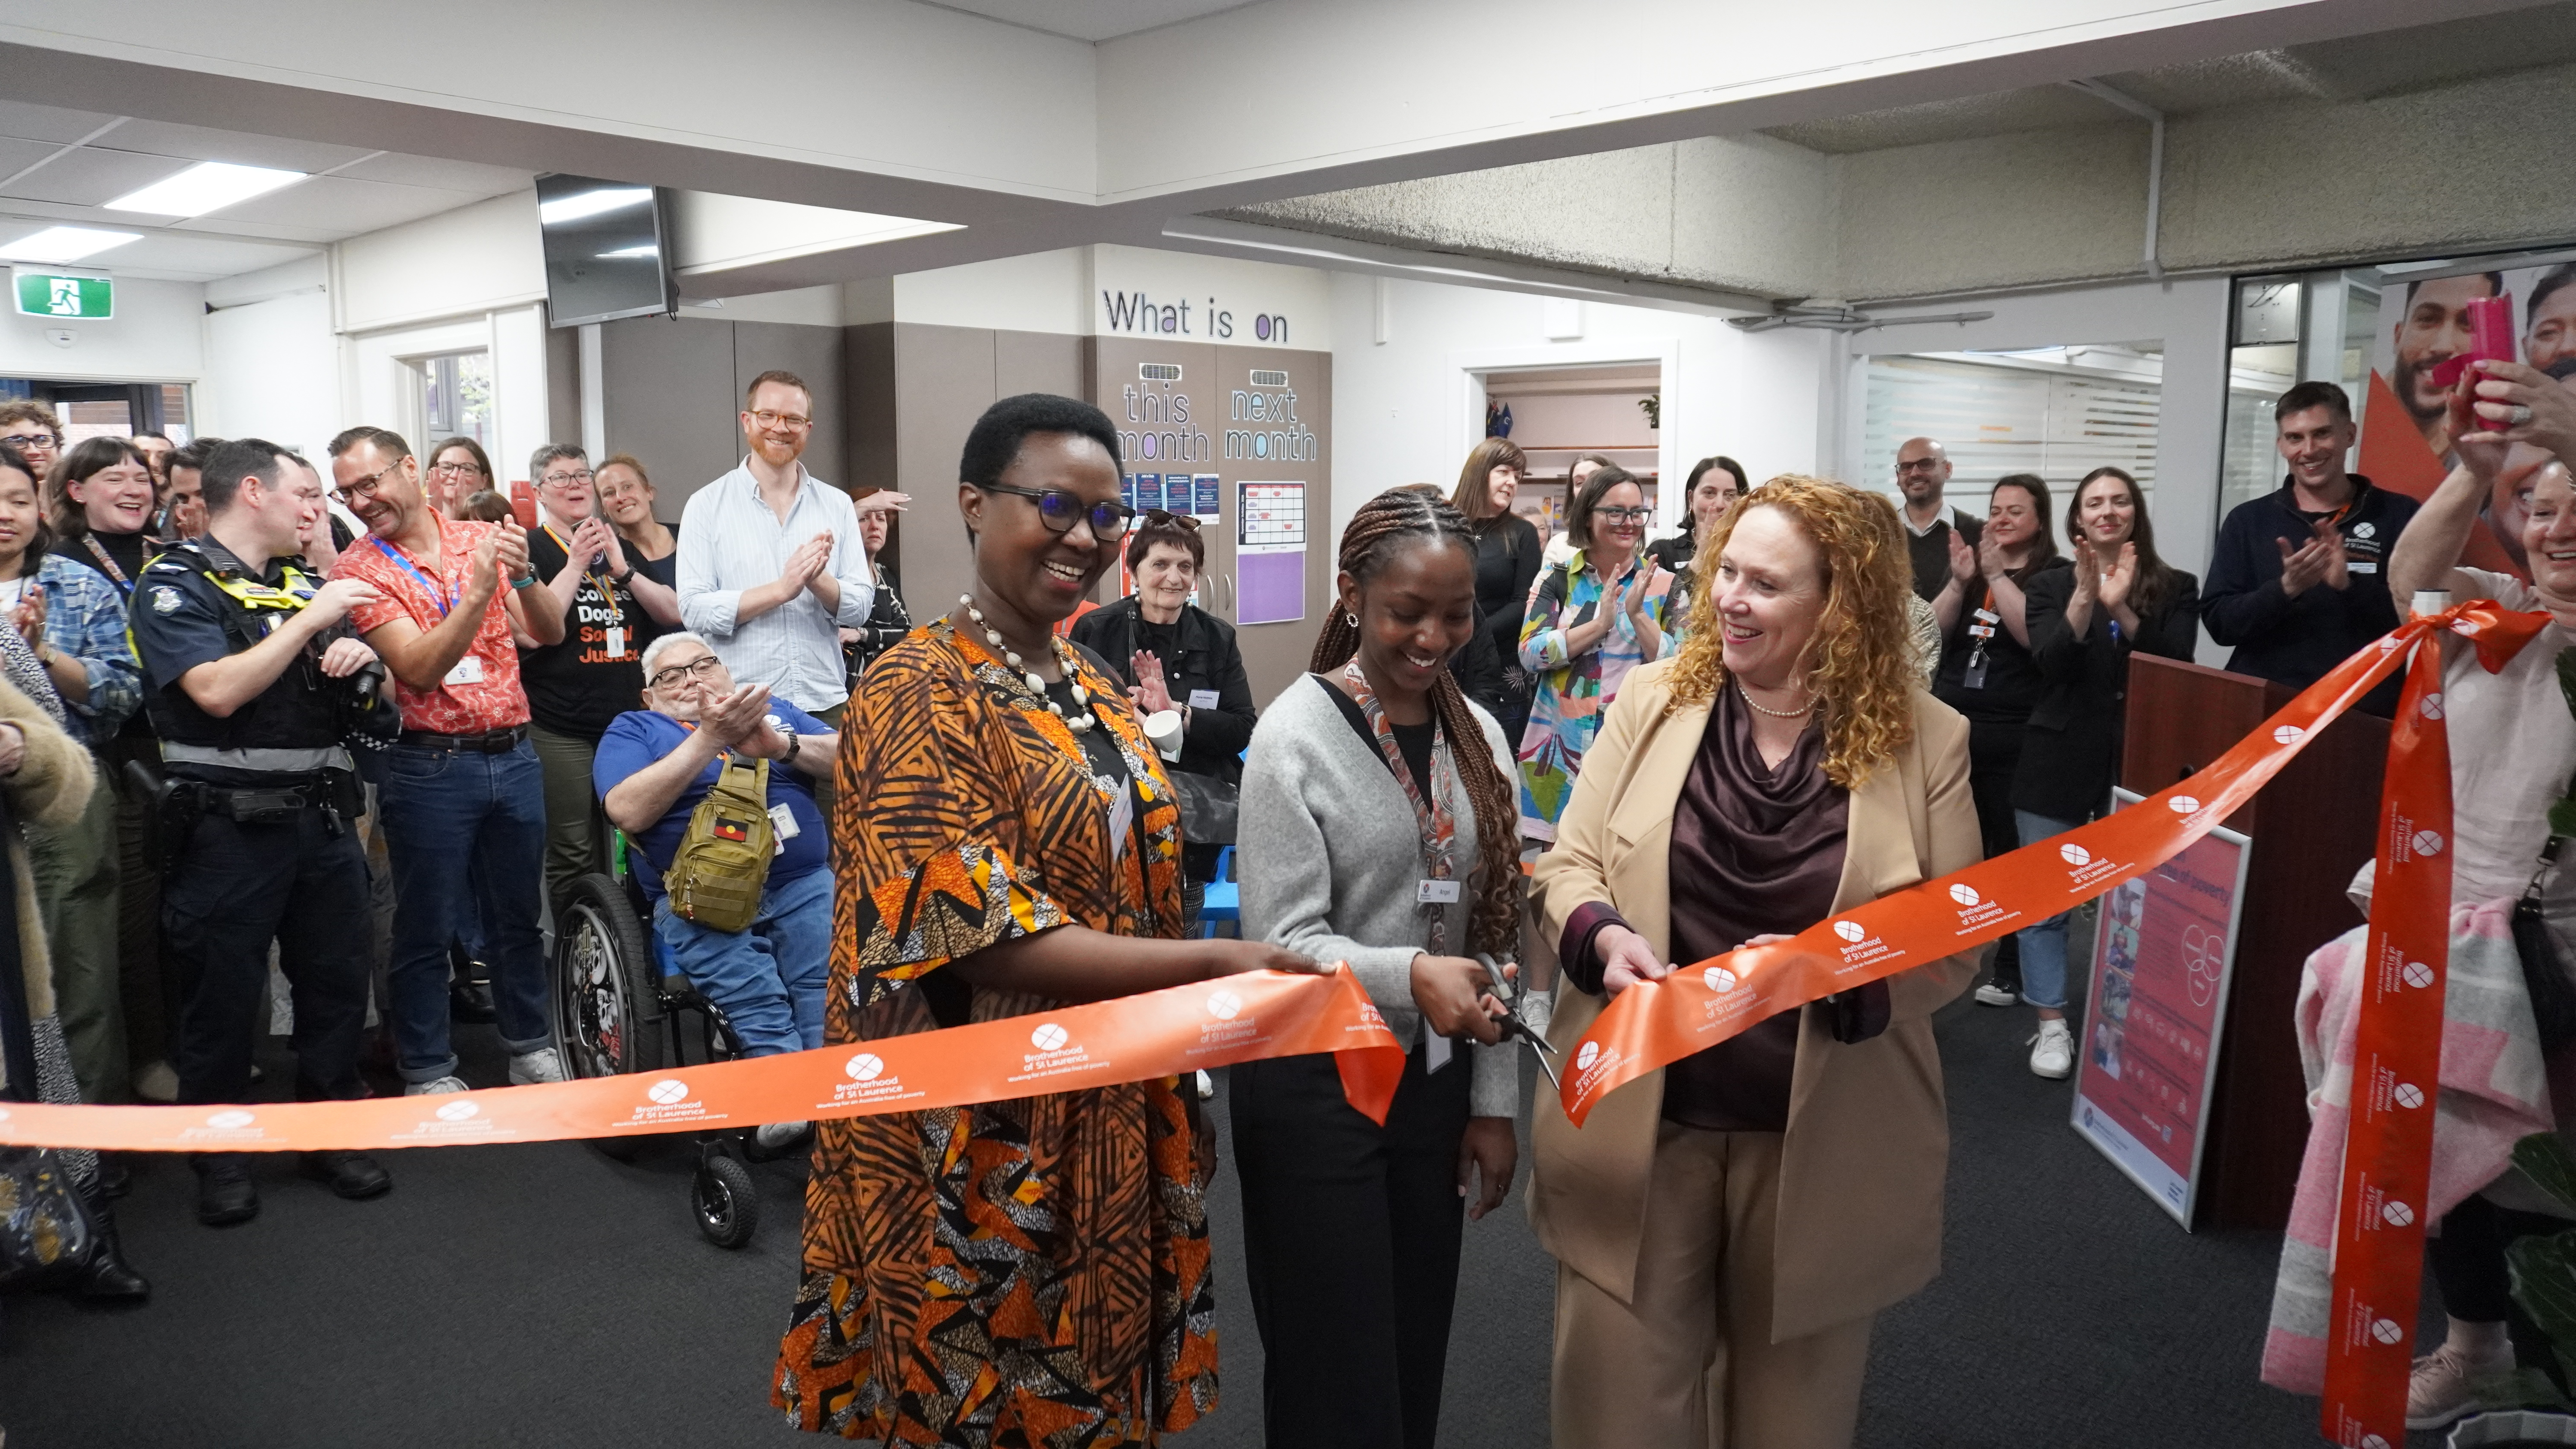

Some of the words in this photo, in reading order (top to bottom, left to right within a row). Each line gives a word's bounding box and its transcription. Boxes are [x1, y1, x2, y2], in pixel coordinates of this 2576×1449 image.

[1103, 289, 1191, 334] What
[1209, 296, 1233, 339] is
[1255, 313, 1288, 343] on
[1124, 382, 1190, 424] this
[1232, 388, 1297, 422] next
[1117, 424, 1209, 461] month
[1225, 424, 1316, 461] month
[574, 588, 632, 602] Cofee
[577, 605, 624, 625] Dogs
[580, 624, 632, 642] Soal
[2397, 815, 2405, 823] of
[2395, 831, 2404, 862] Laurence
[2403, 818, 2413, 862] Brotherhood
[2068, 857, 2108, 877] Brotherhood
[2080, 872, 2090, 880] St
[2087, 862, 2117, 878] Laurence
[1957, 900, 1996, 918] Brotherhood
[1961, 917, 1970, 925] of
[1968, 915, 1977, 923] St
[1975, 907, 2004, 921] Laurence
[1839, 936, 1882, 955] Brotherhood
[1844, 953, 1852, 963] of
[1851, 952, 1859, 961] St
[1858, 945, 1888, 958] Laurence
[2388, 946, 2396, 954] of
[2385, 962, 2394, 993] Laurence
[2393, 950, 2403, 993] Brotherhood
[1704, 983, 1752, 1009] Brotherhood
[1706, 1008, 1715, 1019] of
[1715, 1005, 1725, 1015] St
[1724, 993, 1756, 1011] Laurence
[1201, 1017, 1254, 1031] Brotherhood
[1360, 1011, 1370, 1021] of
[1370, 1012, 1379, 1021] St
[1200, 1033, 1209, 1043] of
[1211, 1032, 1219, 1042] St
[1220, 1028, 1257, 1040] Laurence
[1023, 1062, 1033, 1072] of
[1035, 1061, 1046, 1069] St
[1046, 1054, 1088, 1067] Laurence
[1024, 1045, 1083, 1063] Brotherhood
[1007, 1073, 1032, 1082] Working
[1047, 1067, 1071, 1075] Australia
[1088, 1061, 1110, 1069] poverty
[1575, 1047, 1613, 1088] Brotherhood
[1577, 1083, 1583, 1095] of
[1583, 1077, 1591, 1088] St
[1589, 1053, 1621, 1081] Laurence
[2379, 1066, 2388, 1074] of
[833, 1091, 844, 1100] of
[847, 1090, 857, 1098] St
[858, 1085, 903, 1097] Laurence
[835, 1076, 898, 1092] Brotherhood
[2384, 1070, 2396, 1112] Brotherhood
[902, 1091, 925, 1099] poverty
[2375, 1081, 2386, 1112] Laurence
[631, 1111, 644, 1120] of
[658, 1108, 706, 1117] Laurence
[635, 1100, 702, 1113] Brotherhood
